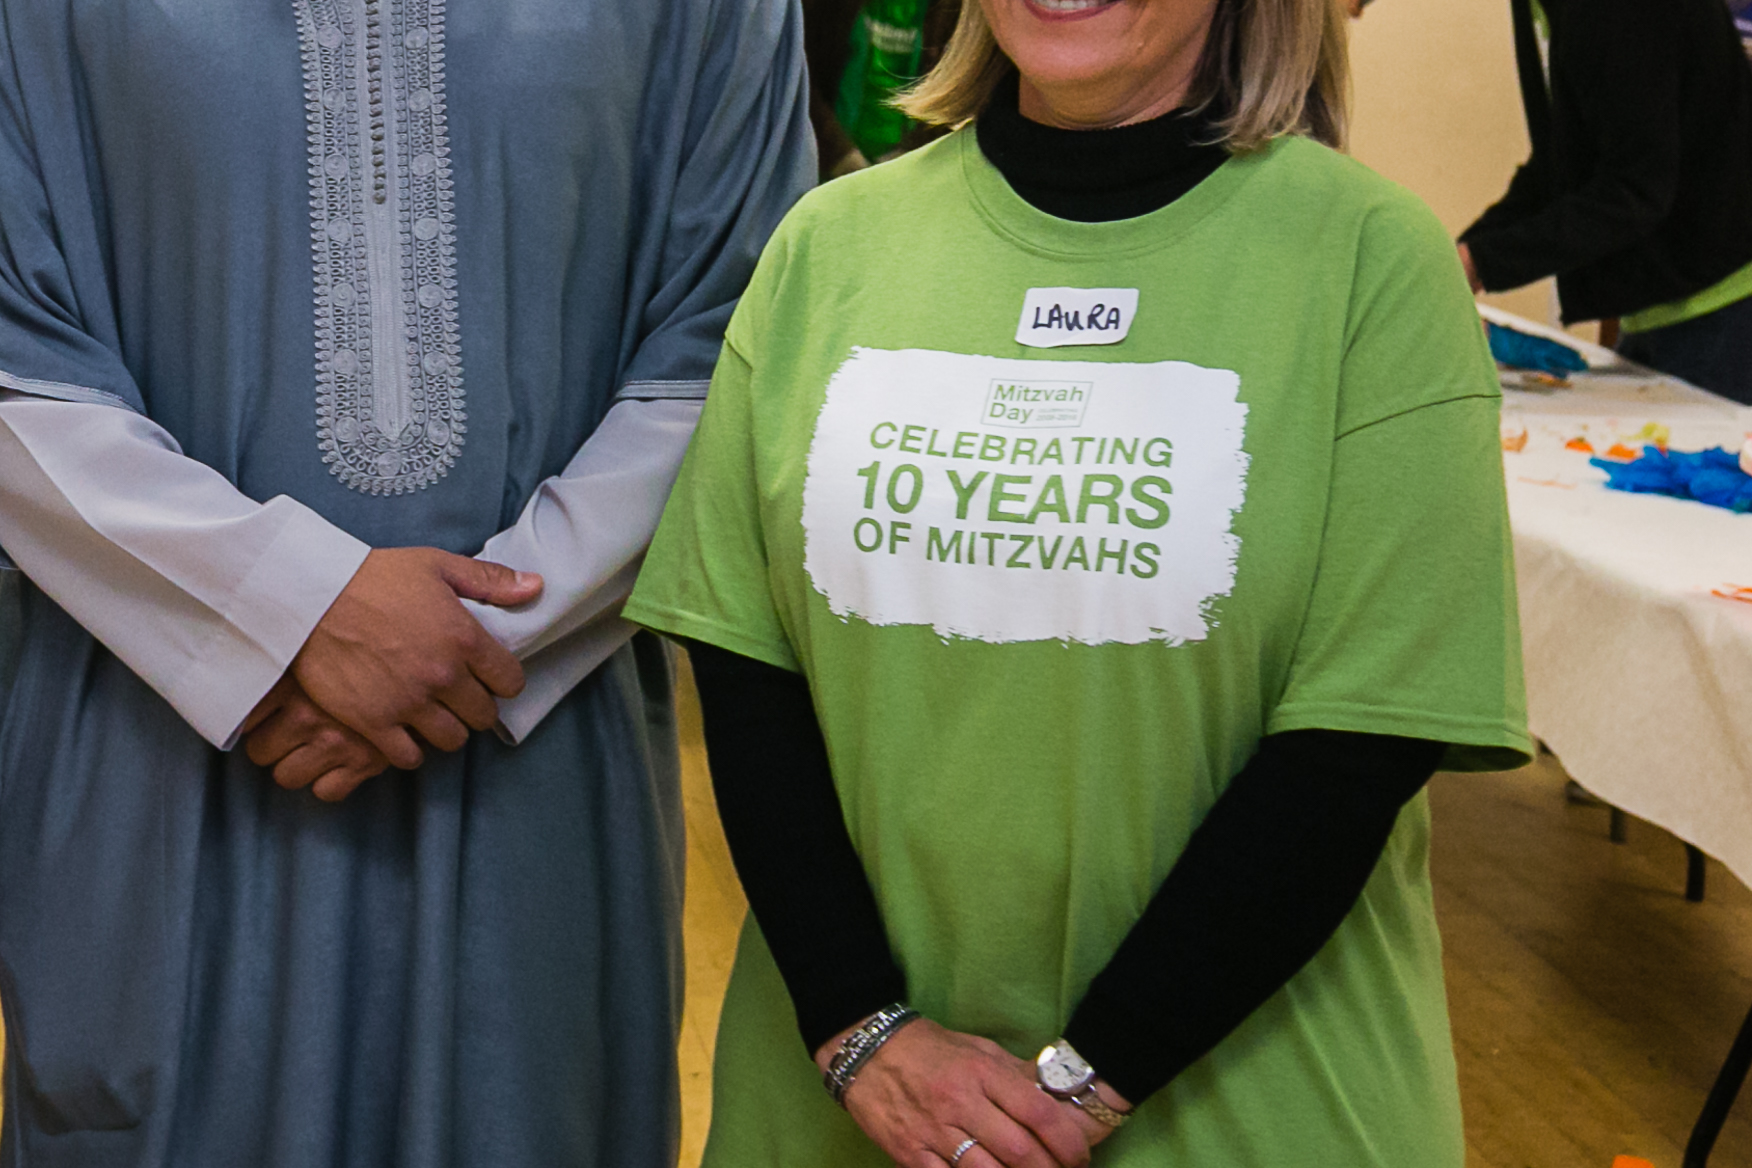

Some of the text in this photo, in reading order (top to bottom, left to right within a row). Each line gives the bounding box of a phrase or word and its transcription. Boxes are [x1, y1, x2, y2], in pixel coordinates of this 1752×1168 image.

[1032, 303, 1121, 332] LAURA
[993, 384, 1083, 402] Mitzvah
[989, 402, 1034, 424] Day
[869, 421, 1174, 469] CELEBRATING
[855, 460, 1174, 530] 10 YEARS
[852, 517, 1162, 580] OF MITZVAHS
